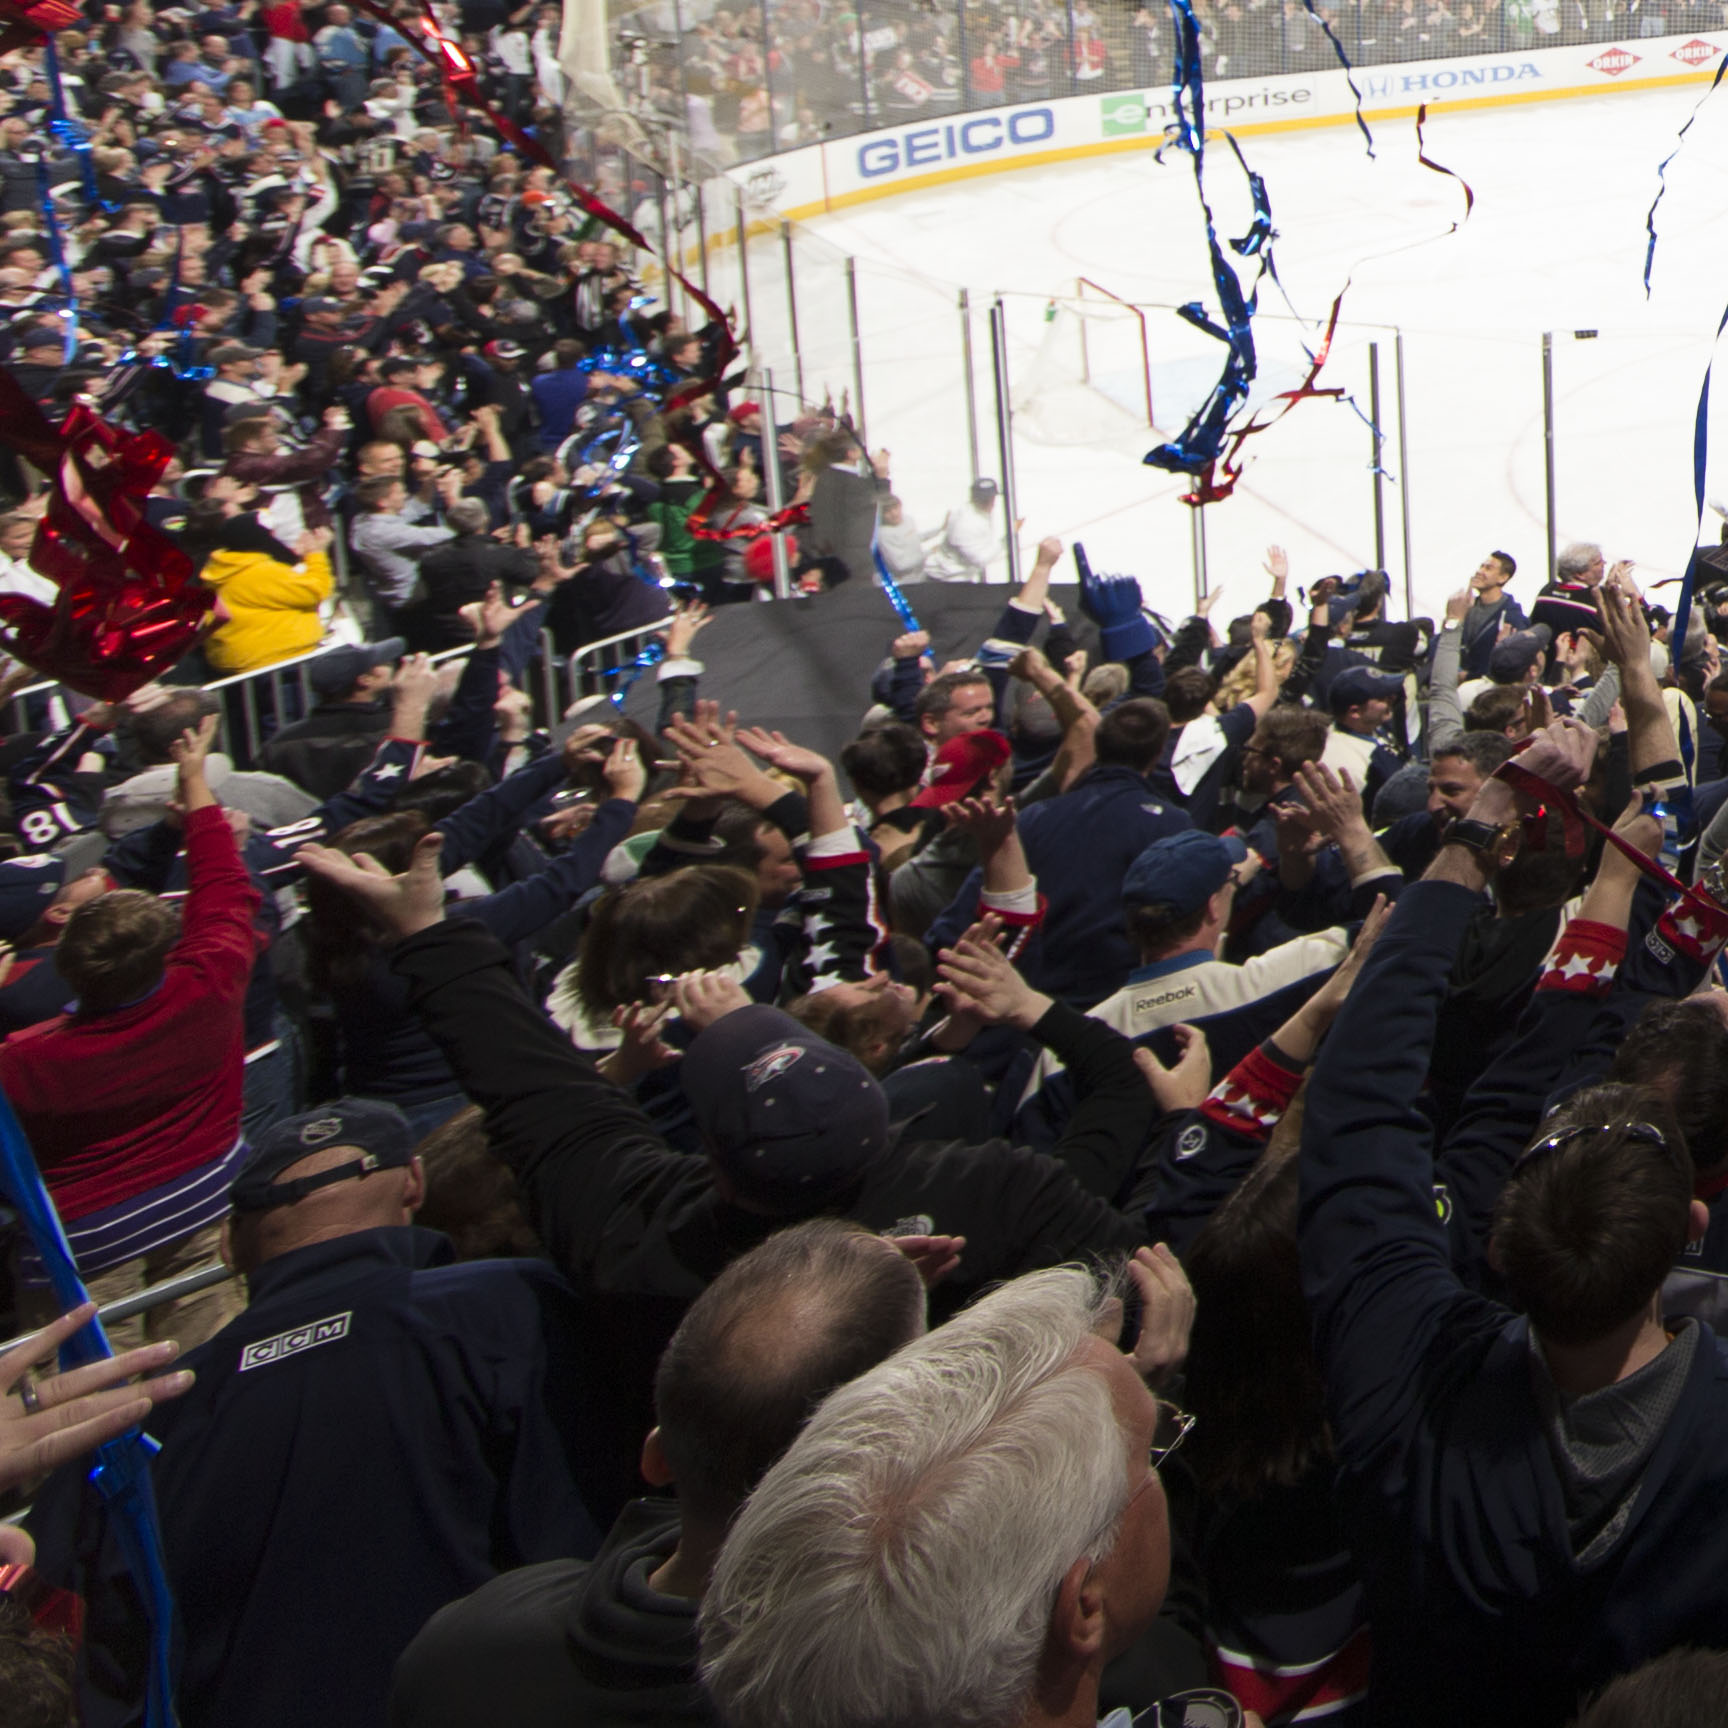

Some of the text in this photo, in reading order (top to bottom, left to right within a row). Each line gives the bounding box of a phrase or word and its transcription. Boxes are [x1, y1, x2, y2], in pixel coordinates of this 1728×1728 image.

[1593, 52, 1635, 69] ORKIN
[1675, 44, 1714, 60] ORKIN
[1402, 62, 1542, 92] HONDA
[1117, 87, 1312, 122] enrprise
[858, 107, 1055, 179] GEICO
[1135, 985, 1196, 1013] Reebok
[245, 1318, 346, 1366] CCM
